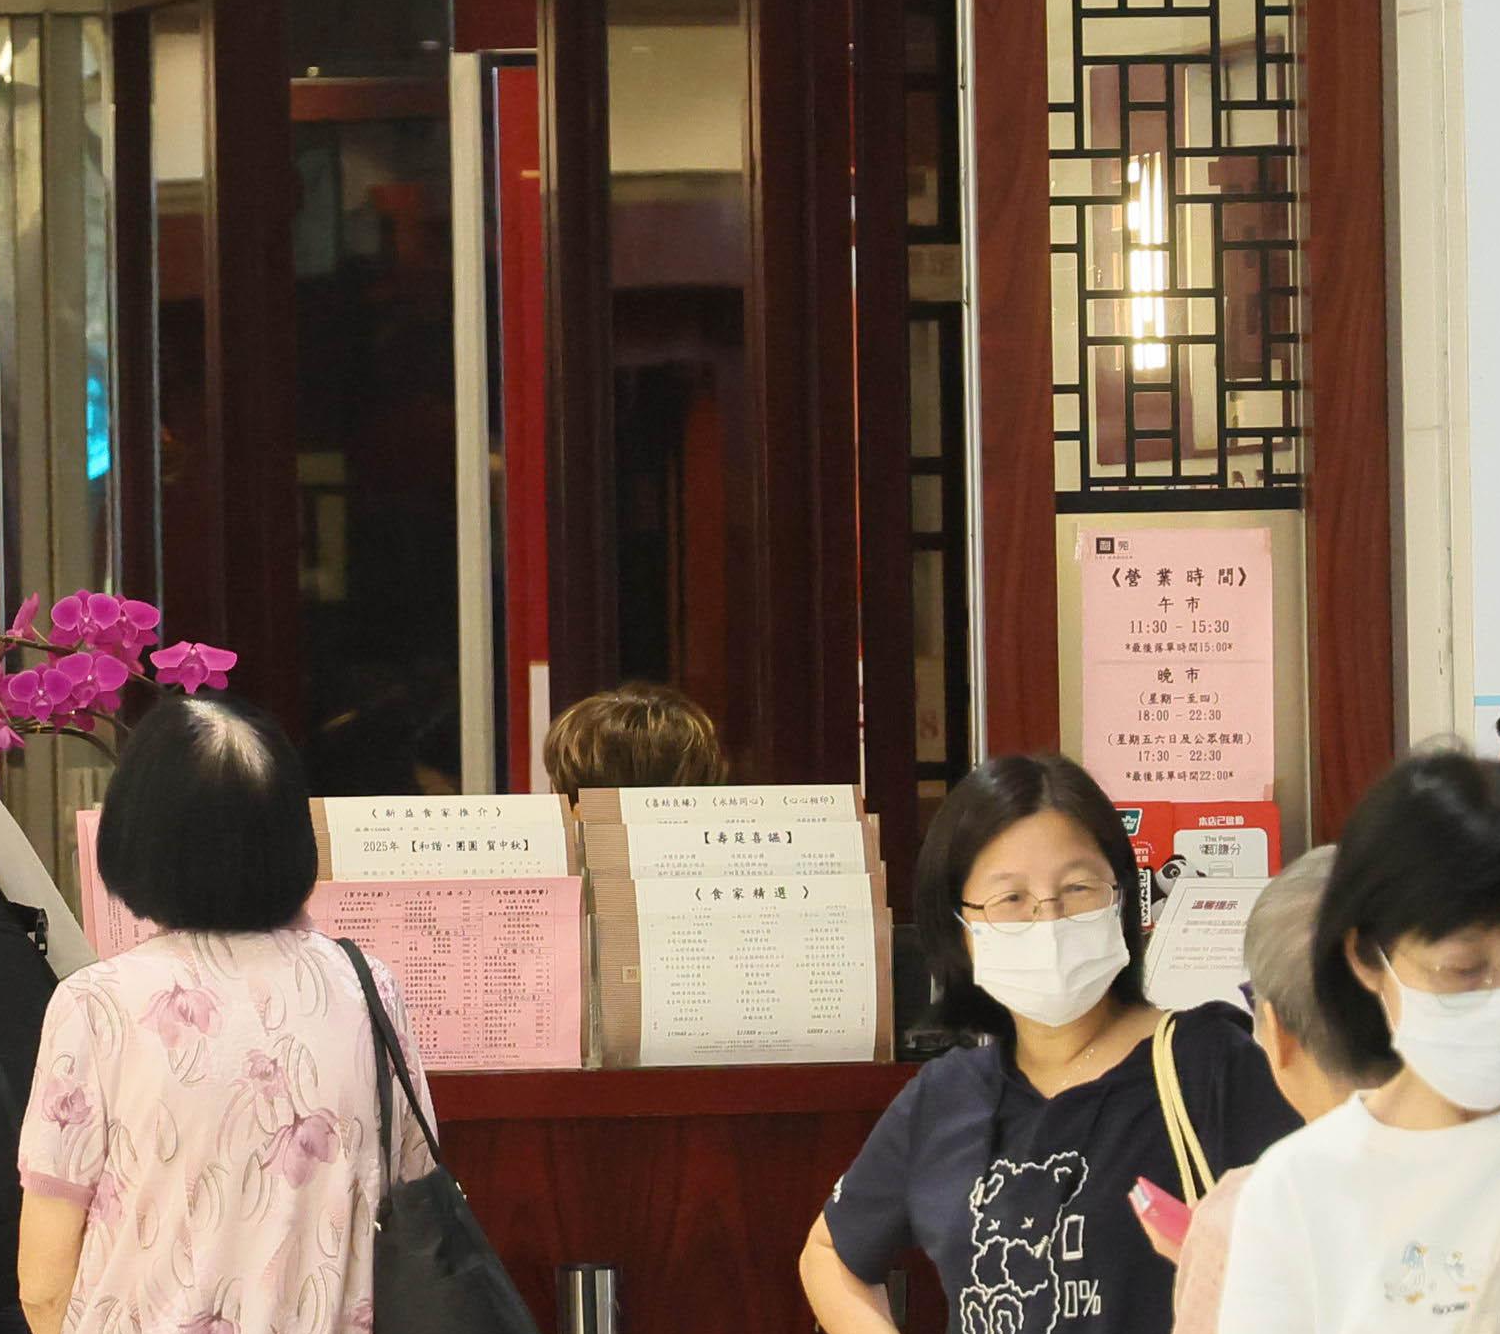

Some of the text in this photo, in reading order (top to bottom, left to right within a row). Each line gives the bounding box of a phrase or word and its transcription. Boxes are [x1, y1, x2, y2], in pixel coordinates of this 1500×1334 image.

[1157, 596, 1201, 614] 午市
[1130, 619, 1168, 633] 11:30
[1191, 619, 1230, 633] 15:30
[1157, 667, 1201, 684] 晚市
[1137, 709, 1170, 722] 18:00
[1188, 709, 1222, 721] 22:30
[1137, 749, 1170, 762] 17:30
[1188, 749, 1222, 762] 22:30
[363, 840, 400, 852] 2025年
[1063, 1279, 1102, 1318] 0%
